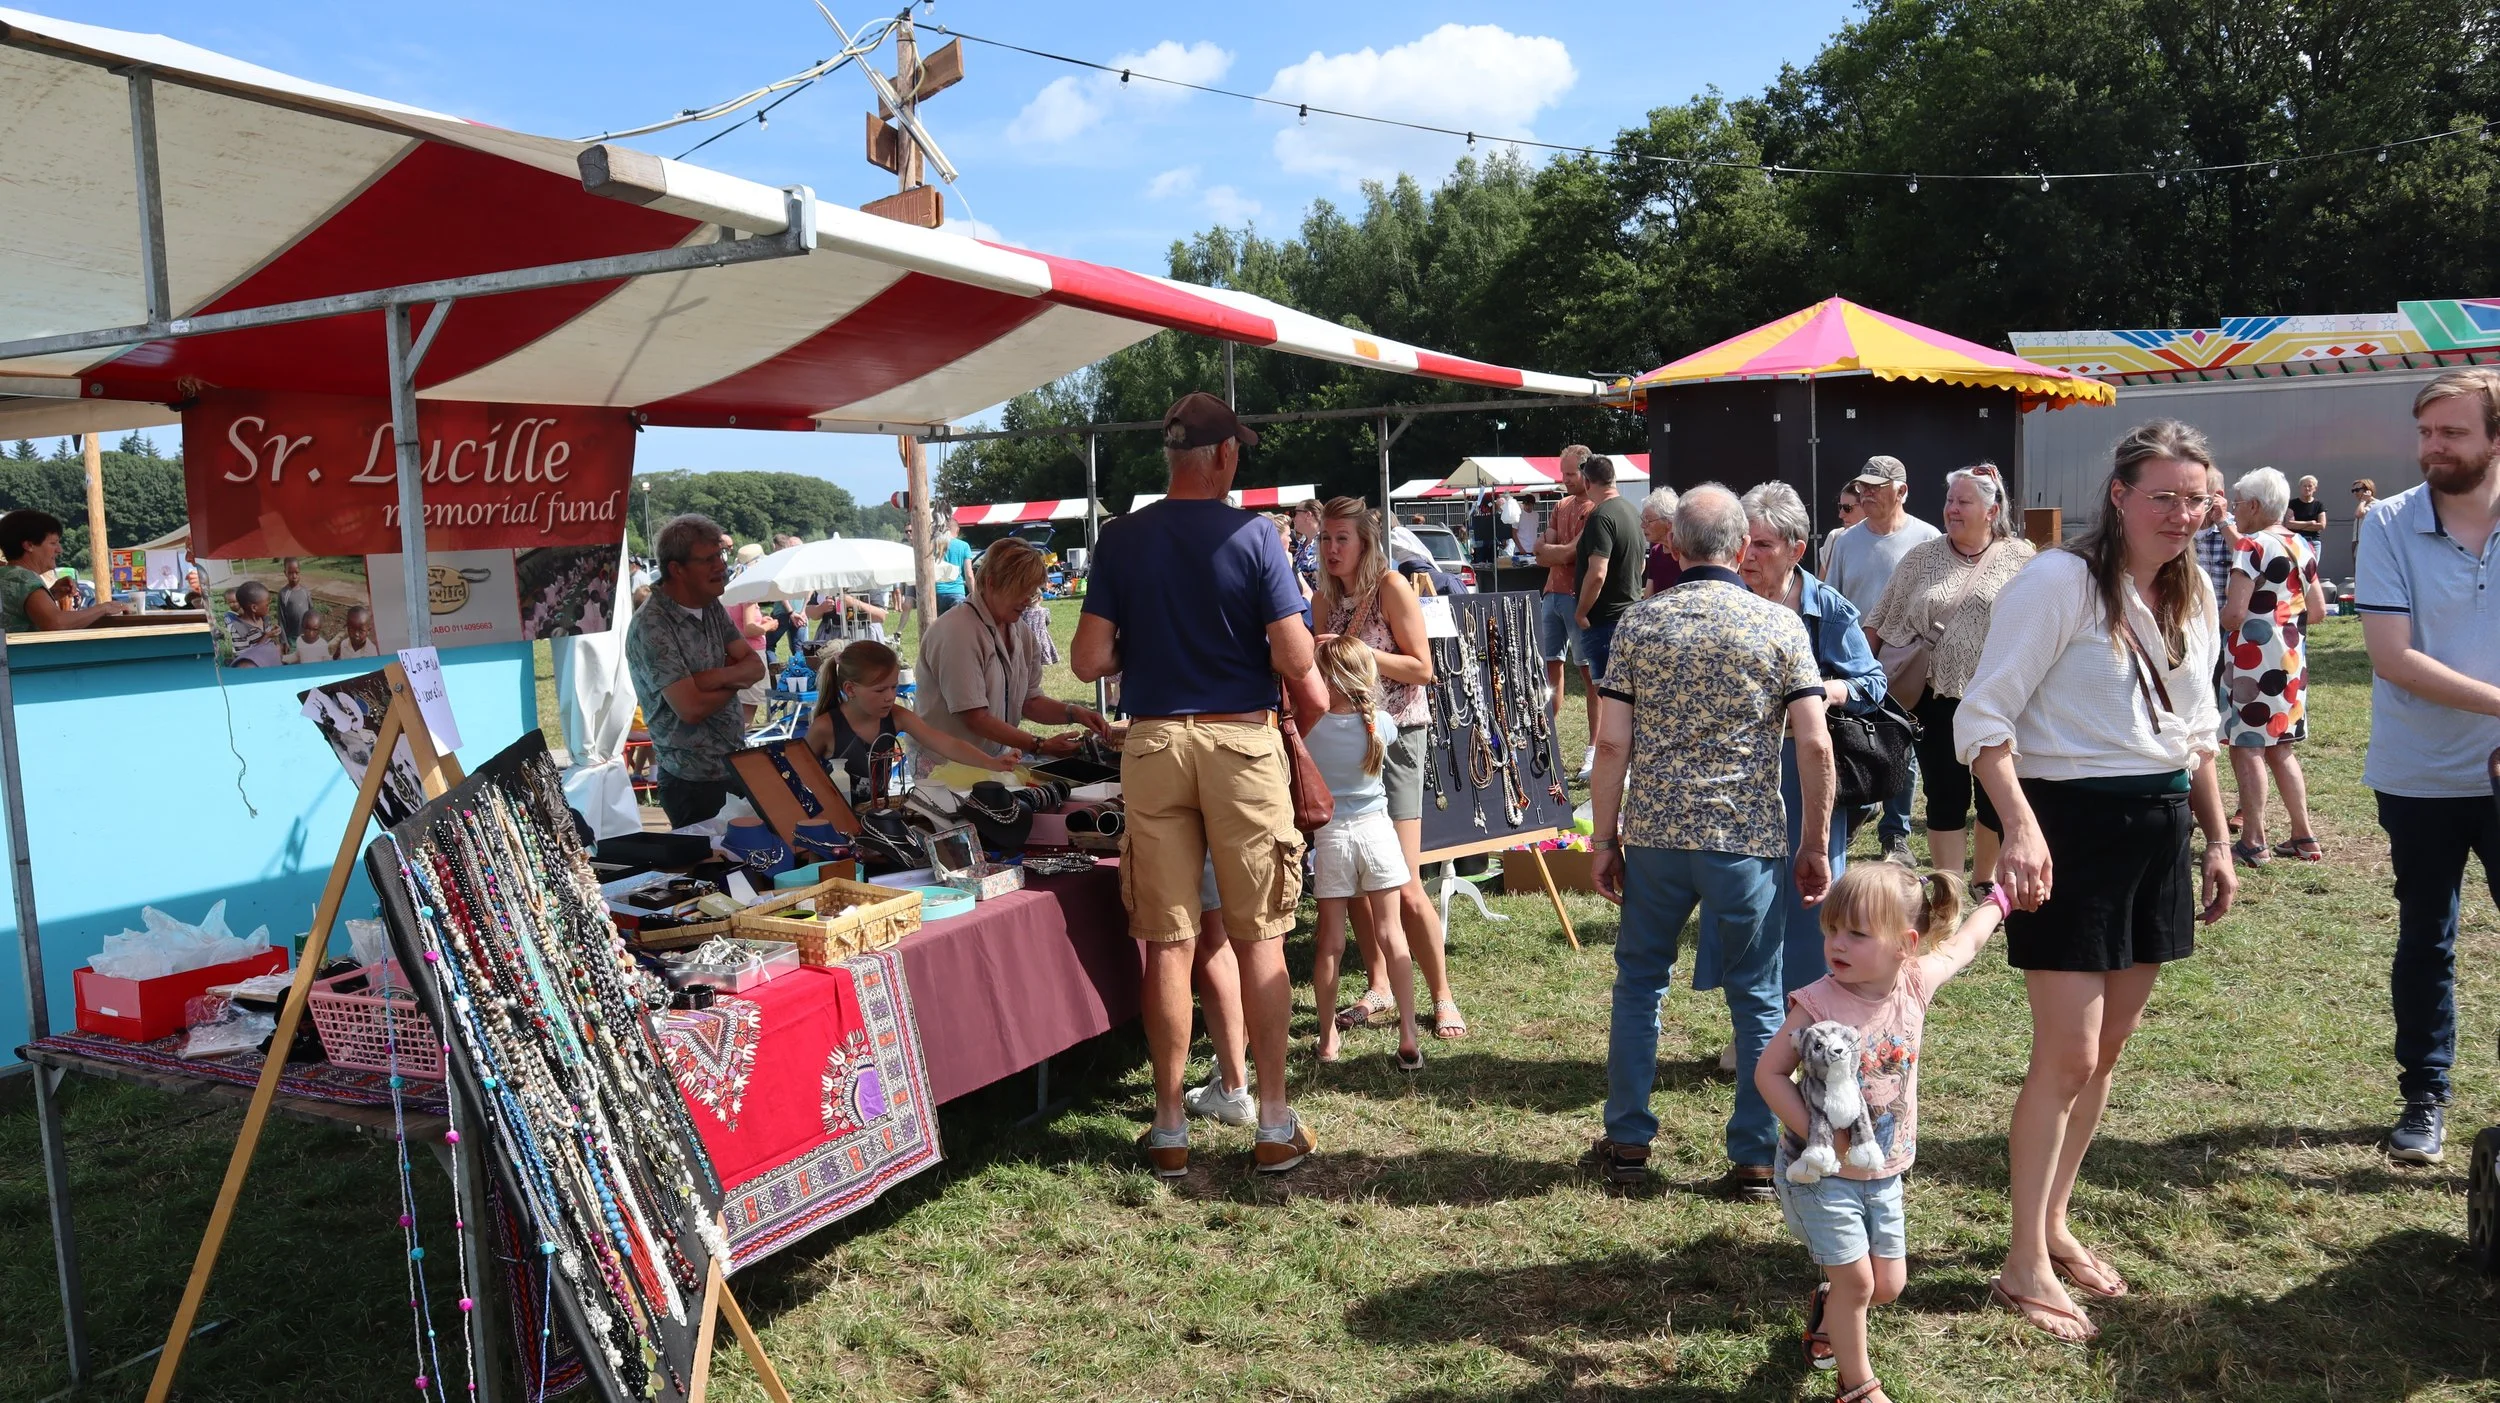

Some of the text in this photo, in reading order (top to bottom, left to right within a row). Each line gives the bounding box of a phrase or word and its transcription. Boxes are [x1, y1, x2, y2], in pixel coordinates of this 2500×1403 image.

[224, 415, 570, 484] Sr. Lucille
[542, 490, 621, 534] fund
[431, 625, 450, 635] ABO
